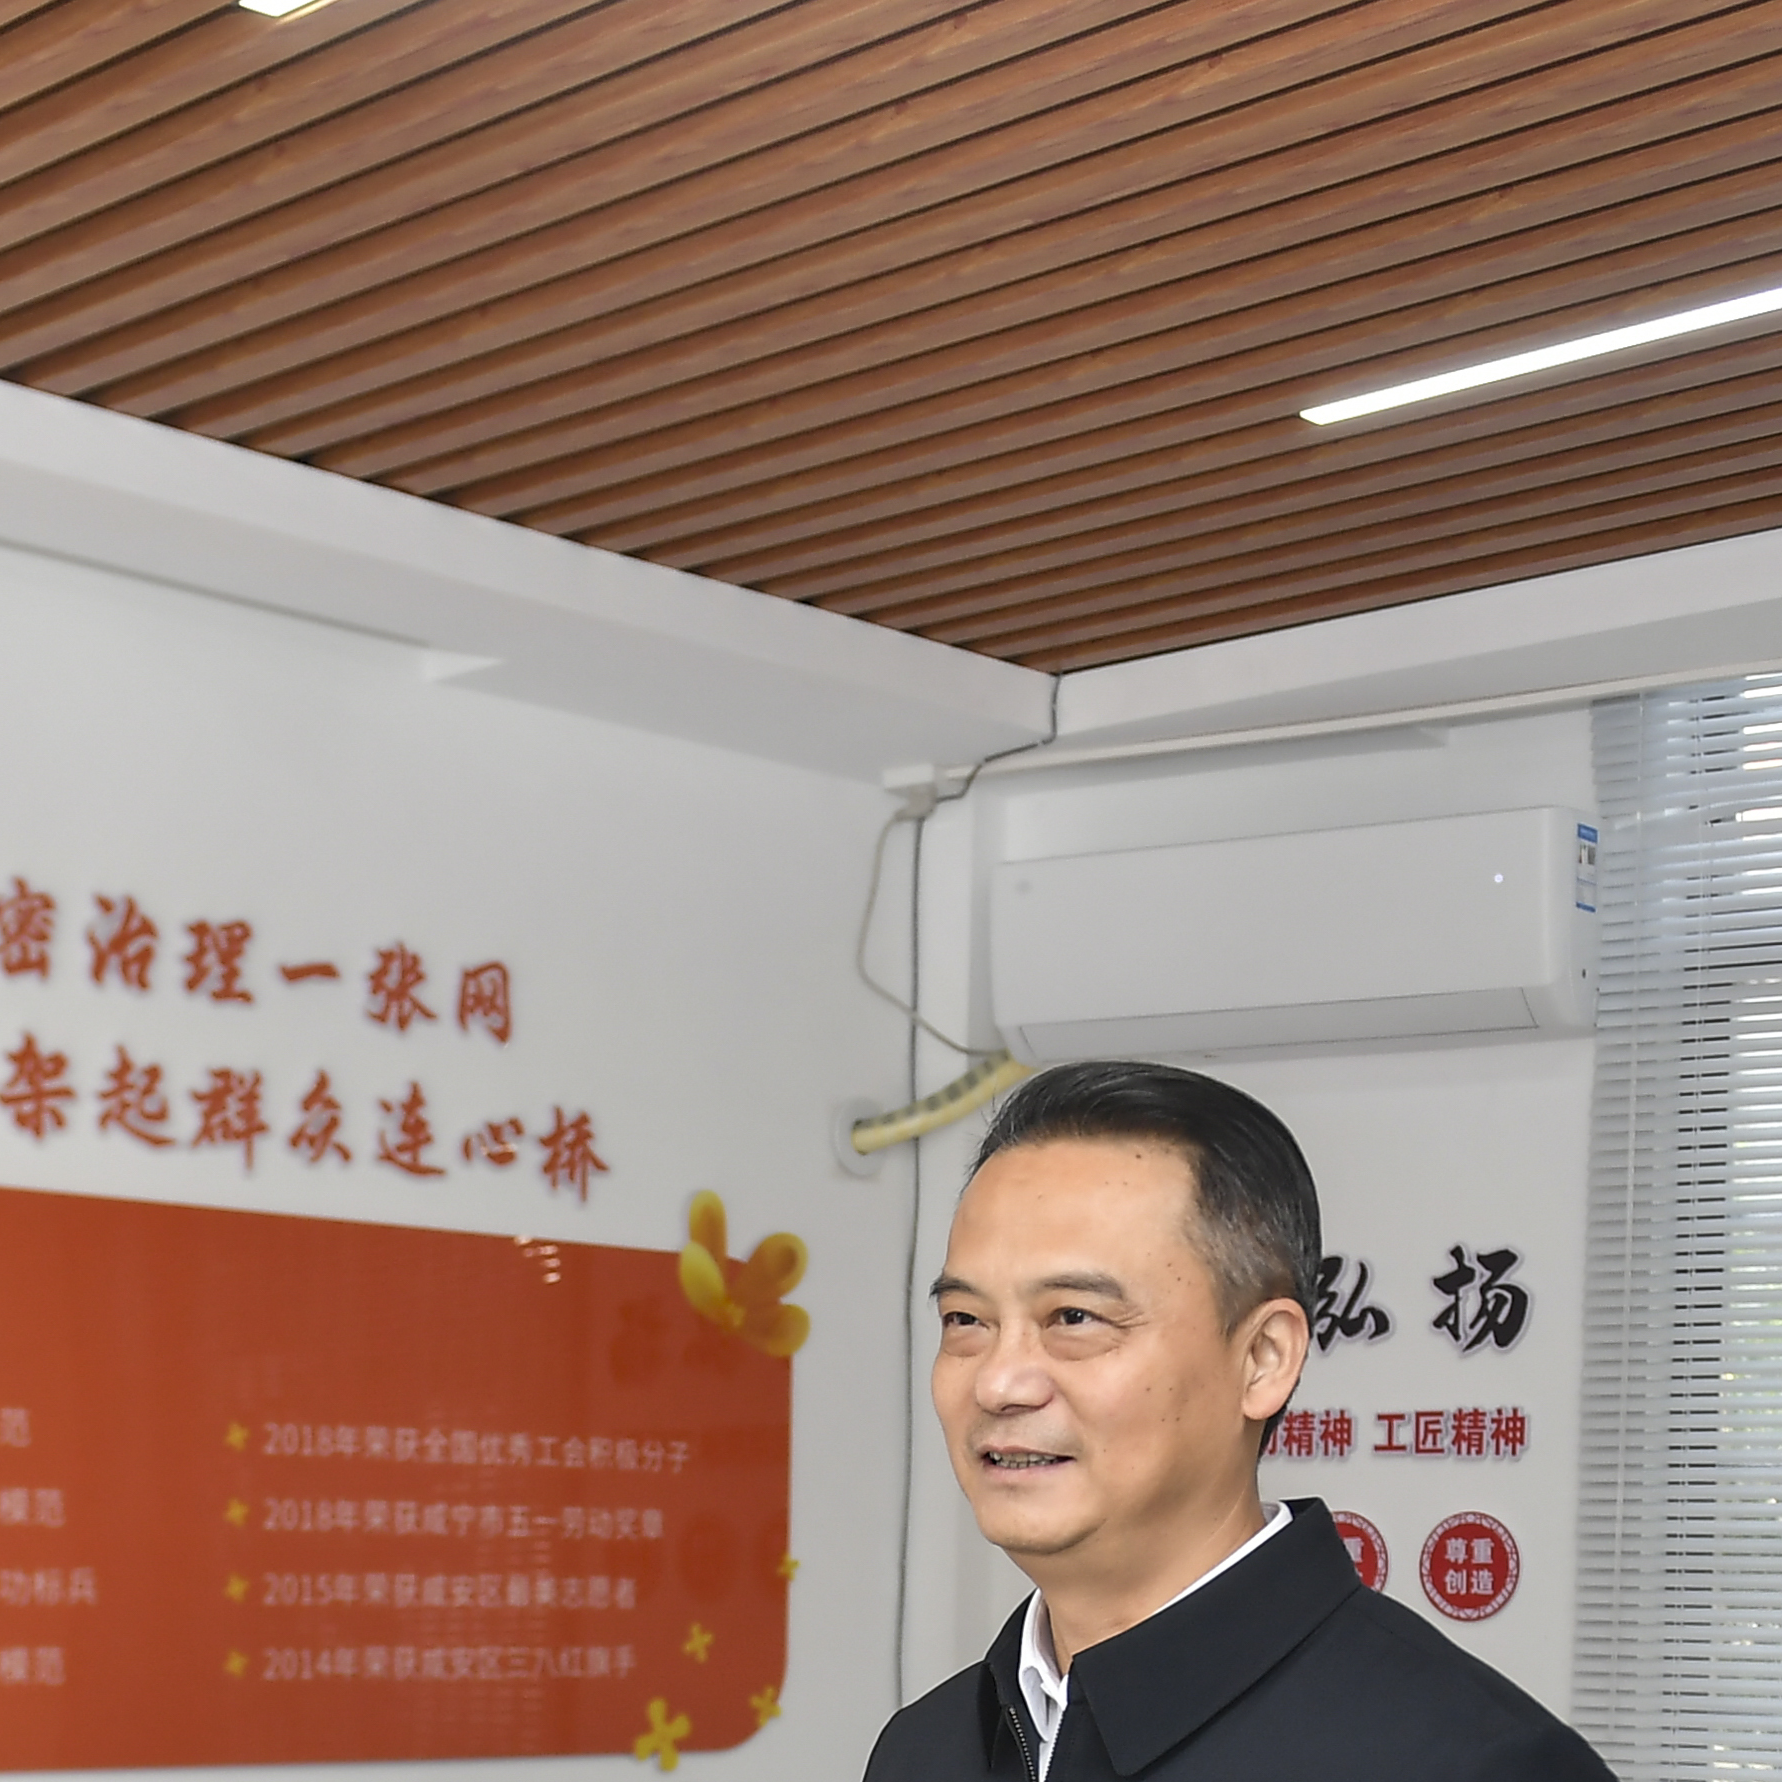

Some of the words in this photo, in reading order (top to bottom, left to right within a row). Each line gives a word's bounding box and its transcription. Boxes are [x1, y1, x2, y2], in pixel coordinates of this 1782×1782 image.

[1315, 1245, 1529, 1353] 弘扬
[1374, 1407, 1526, 1457] 工匠精神
[1445, 1537, 1495, 1565] 尊重
[1444, 1568, 1495, 1596] 创造
